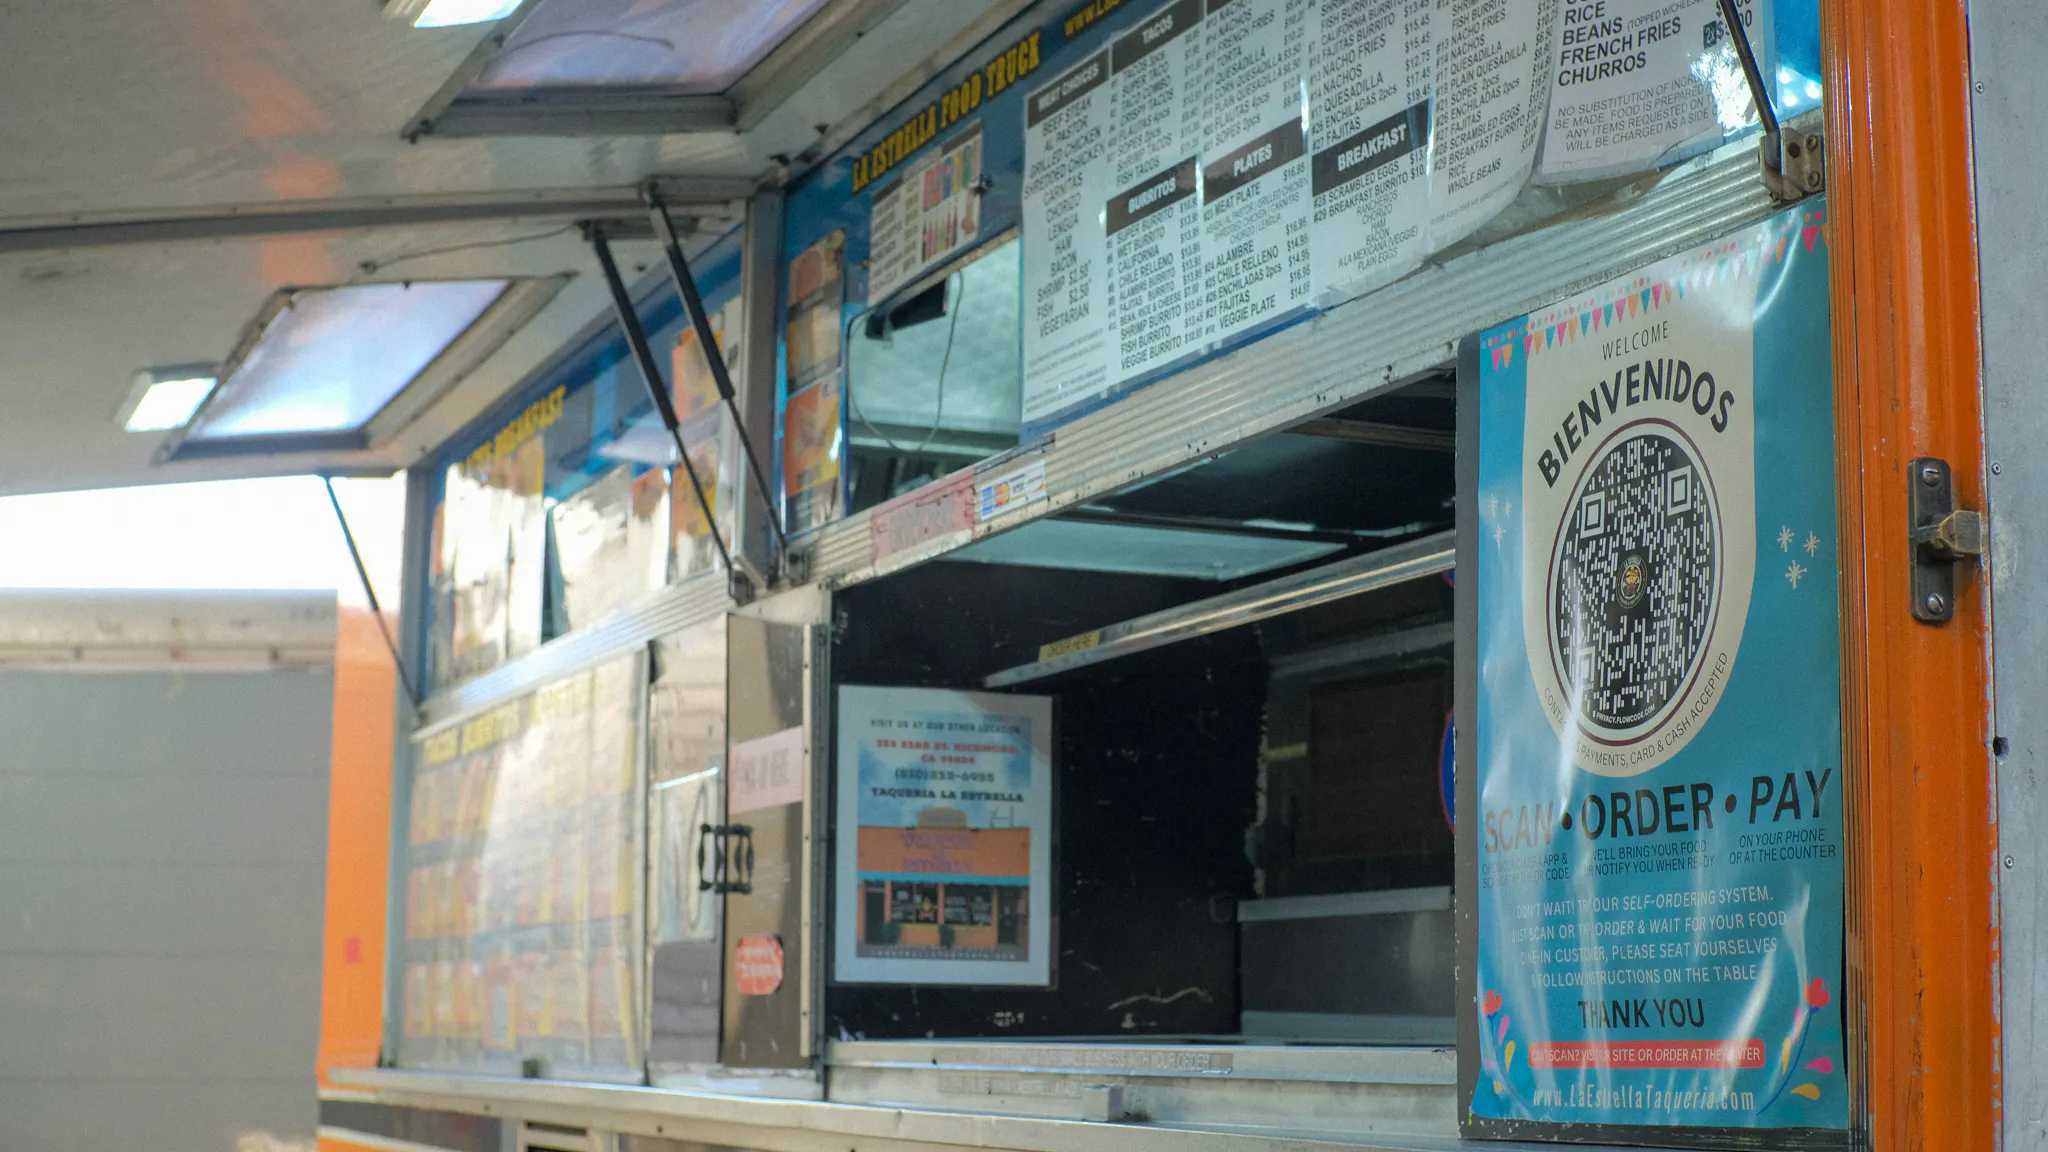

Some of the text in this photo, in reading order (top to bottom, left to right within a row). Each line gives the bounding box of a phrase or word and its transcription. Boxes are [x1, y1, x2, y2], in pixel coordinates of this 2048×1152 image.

[1142, 14, 1174, 45] TACOS
[1451, 8, 1506, 46] NACHO FRIES
[1562, 9, 1660, 47] BEANS (TOPPED
[1564, 0, 1606, 26] RICE
[1323, 49, 1356, 78] NACHO
[1358, 33, 1387, 59] FRIES
[1450, 40, 1502, 77] QUESADILLA
[1559, 16, 1682, 67] FRENCH FRIES
[1323, 63, 1363, 94] NACHOS
[1558, 51, 1648, 87] CHURROS
[1324, 71, 1384, 113] QUESADILLA
[1450, 87, 1500, 121] ENCHILADAS
[1554, 118, 1570, 130] BE
[1610, 106, 1641, 122] FOOD
[1642, 102, 1652, 113] IS
[1654, 84, 1704, 108] PREPARED
[1558, 83, 1670, 118] NO SUBSTITUTION OF
[852, 31, 1041, 194] LA ESTRELLA FOOD TRUCK
[1325, 92, 1376, 129] ENCHILADAS
[1565, 98, 1704, 140] ANY ITEMS REQUESTED ON
[1326, 116, 1361, 145] FAJITAS
[1337, 123, 1408, 172] BREAKFAST
[1565, 109, 1710, 152] WILL BE CHARGED AS A SIDE
[1233, 144, 1273, 177] PLATES
[1447, 168, 1477, 196] WHOLE
[1476, 158, 1502, 181] BEANS
[1448, 161, 1467, 181] RICE
[1128, 177, 1177, 214] BURRITOS
[1328, 160, 1400, 201] SCRAMBLED EGGS
[1328, 188, 1373, 217] BREAKFAST
[1374, 171, 1409, 196] BURRITO
[1214, 182, 1261, 217] MEAT PLATE
[1362, 203, 1393, 225] CHORIZO
[1352, 225, 1419, 264] MEXICANA (VEGGIE)
[1365, 227, 1390, 246] BACON
[1117, 246, 1160, 274] CALIFORNIA
[1215, 240, 1255, 269] ALAMBRE
[1217, 245, 1279, 285] CHILE RELLENO
[1357, 248, 1398, 273] PLAIN EGGS
[1218, 270, 1264, 300] ENCHILADAS
[1219, 289, 1251, 315] FAJITAS
[1039, 302, 1090, 338] VEGETARIAN
[1219, 294, 1277, 330] VEGGIE PLATE
[1121, 339, 1138, 356] FISH
[1138, 324, 1171, 348] BURRITO
[1121, 335, 1183, 371] VEGGIE BURRITO
[1602, 320, 1669, 361] WELCOME
[1537, 358, 1735, 489] BIENVENIDOS
[1581, 652, 1729, 769] PAYMENTS, CARD & CASH ACCEPTED
[1595, 704, 1656, 725] PRIVACY.FLOWCODE.COM
[1485, 768, 1833, 854] SCAN ORDER PAY
[1618, 844, 1650, 860] BRING
[1651, 843, 1678, 857] YOUR
[1680, 840, 1707, 855] FOOD
[1729, 844, 1836, 865] OR AT THE COUNTER
[1739, 828, 1826, 848] ON YOUR PHONE
[1544, 853, 1561, 867] APP
[1561, 852, 1568, 865] &
[1545, 868, 1570, 881] CODE
[1595, 855, 1715, 876] NOTIFY YOU WHEN READY
[1516, 885, 1774, 919] DON'T WAIT! OUR SELF-ORDERING SYSTEM.
[1528, 926, 1555, 941] SCAN
[1558, 924, 1575, 939] OR
[1595, 920, 1635, 936] ORDER
[1638, 919, 1646, 934] &
[1649, 918, 1681, 934] WAIT
[1685, 916, 1706, 933] FOR
[1709, 913, 1745, 931] YOUR
[1749, 911, 1787, 928] FOOD
[1521, 937, 1777, 965] DINE-IN CUSTOMER, PLEASE SEAT YOURSELVES
[1538, 964, 1757, 988] FOLLOW INSTRUCTIONS ON THE TABLE
[1578, 998, 1705, 1029] THANK YOU
[1550, 1048, 1721, 1062] SCAN? SITE OR ORDER AT THE
